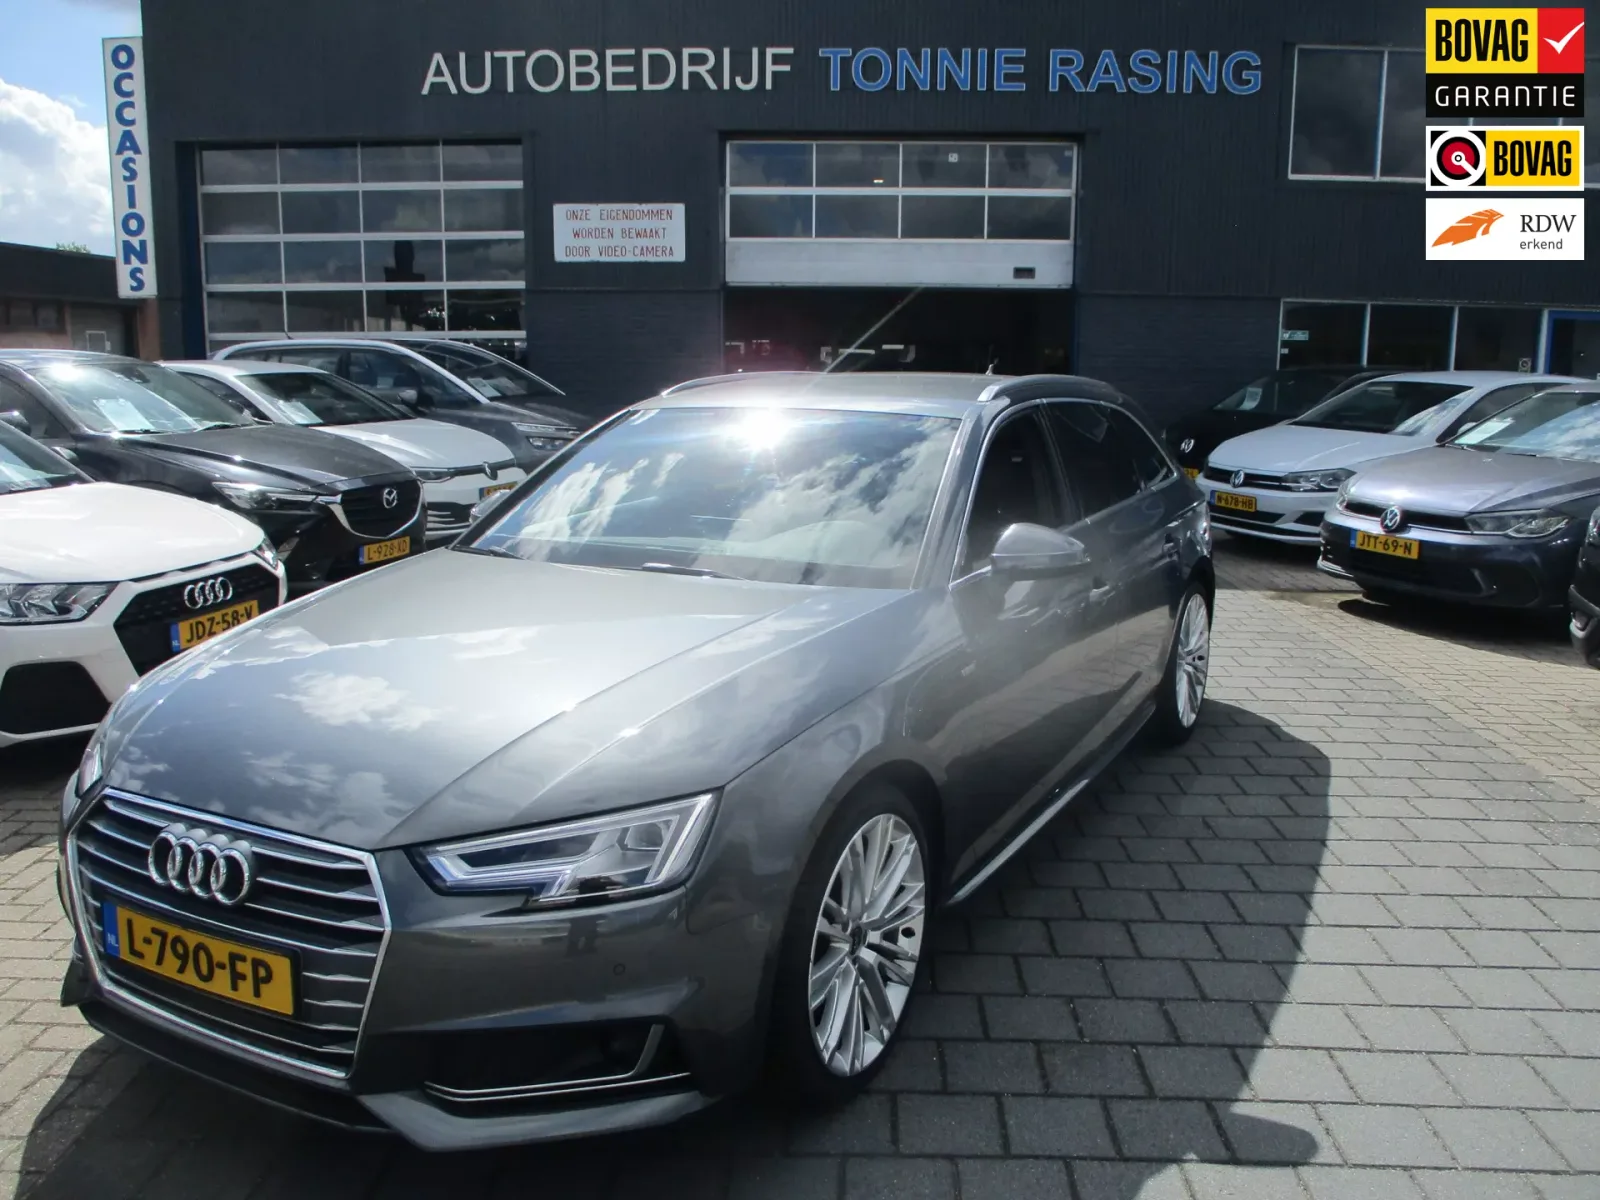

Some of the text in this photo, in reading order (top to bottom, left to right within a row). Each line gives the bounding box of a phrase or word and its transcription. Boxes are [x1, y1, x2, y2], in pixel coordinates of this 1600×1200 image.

[421, 46, 1262, 96] AUTOBEDRIJF TONNIE RASING
[110, 43, 150, 293] OCCASIONS
[565, 208, 673, 221] ONZE EIGENDOMMEN
[572, 227, 667, 240] WORDEN BEWAAKT
[565, 245, 674, 258] DOOR VIDEO-CAMERA
[1358, 533, 1413, 556] JTT-69-N
[185, 604, 254, 643] JDZ-58-V
[126, 918, 273, 999] L-790-FP
